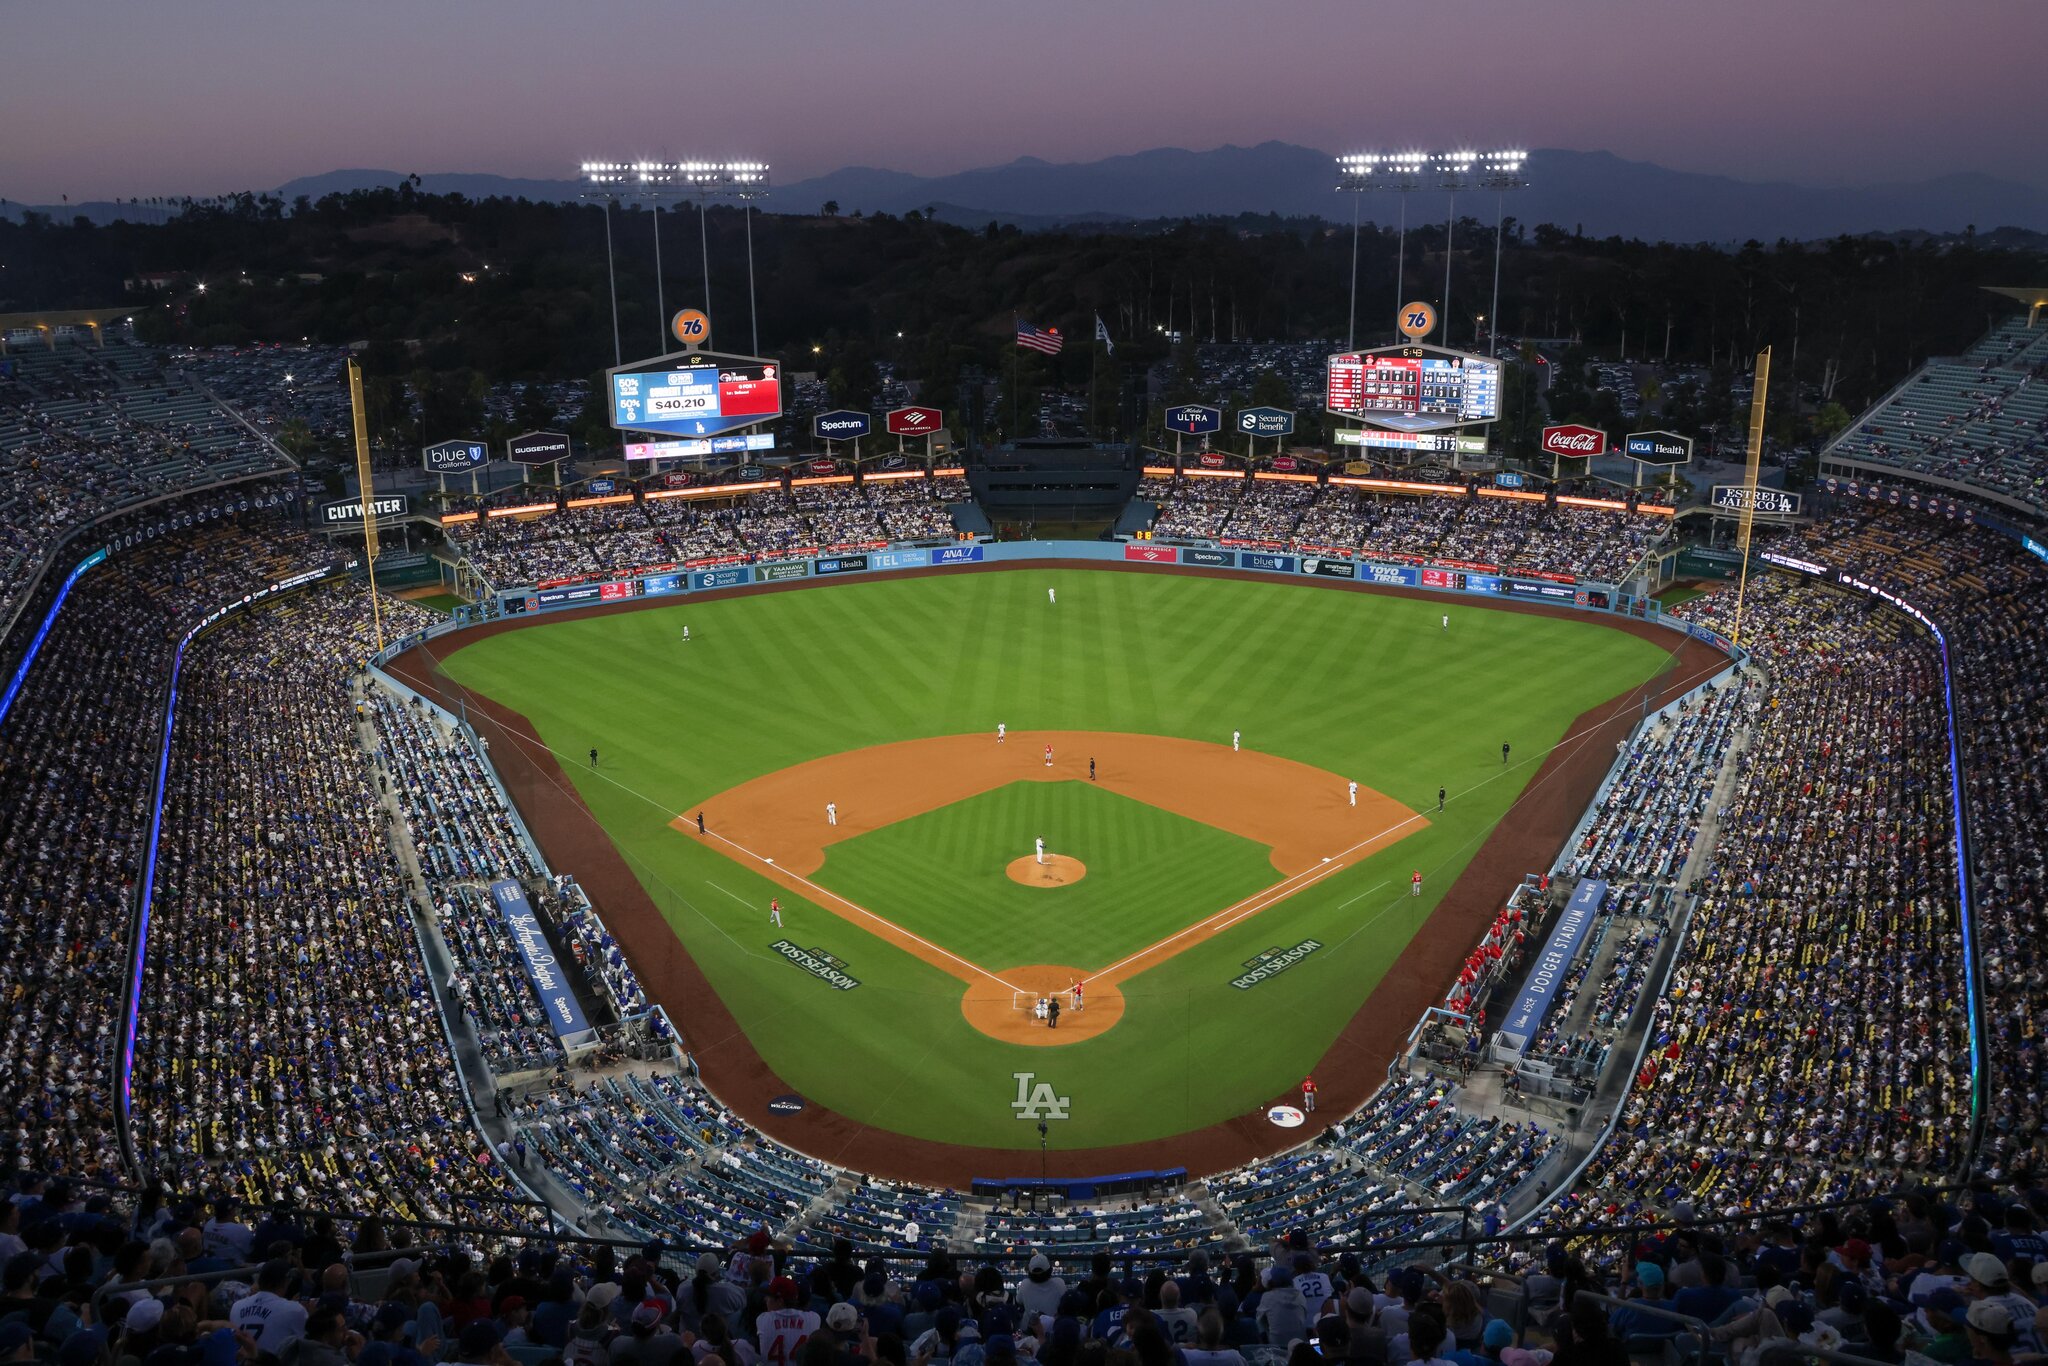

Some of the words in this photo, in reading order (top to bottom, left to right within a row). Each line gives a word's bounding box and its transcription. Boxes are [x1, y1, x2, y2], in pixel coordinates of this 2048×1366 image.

[1406, 311, 1427, 328] 76
[682, 319, 704, 335] 76
[1403, 348, 1423, 357] 6:43
[618, 378, 639, 387] 50%
[620, 399, 640, 408] 50%
[1177, 413, 1208, 422] ULTRA
[1258, 414, 1288, 424] Security
[821, 420, 862, 431] Spectrum
[1258, 423, 1284, 431] Benefit
[1547, 431, 1598, 451] Coca-Cola
[515, 443, 566, 454] GUGGENHEIM
[1630, 442, 1651, 451] UCLA
[1655, 443, 1685, 455] Health
[431, 448, 466, 463] blue
[438, 460, 471, 470] california
[1500, 474, 1519, 485] TEL
[327, 499, 401, 520] CUTWATER
[1720, 497, 1775, 511] JALISCO
[942, 549, 963, 558] ANA
[1194, 553, 1221, 561] Spectrum
[841, 560, 863, 568] Health
[874, 555, 898, 567] TEL
[1253, 556, 1274, 565] blue
[716, 570, 739, 579] Security
[1369, 565, 1399, 575] TOYO
[1373, 573, 1405, 584] TIRES
[1513, 584, 1538, 592] Spectrum
[540, 594, 565, 602] Spectrum
[527, 600, 537, 608] 76
[1530, 951, 1564, 993] DODGER
[1555, 909, 1585, 949] STADIUM
[772, 940, 858, 990] POSTSEASON
[1232, 940, 1321, 989] POSTSEASON
[529, 955, 557, 991] Dodgers
[554, 996, 573, 1024] Spectrum
[1011, 1072, 1070, 1119] LA
[2011, 1239, 2044, 1250] BETTS
[1301, 1281, 1324, 1298] 22
[240, 1305, 272, 1320] OHTANI
[774, 1319, 804, 1330] DUNN
